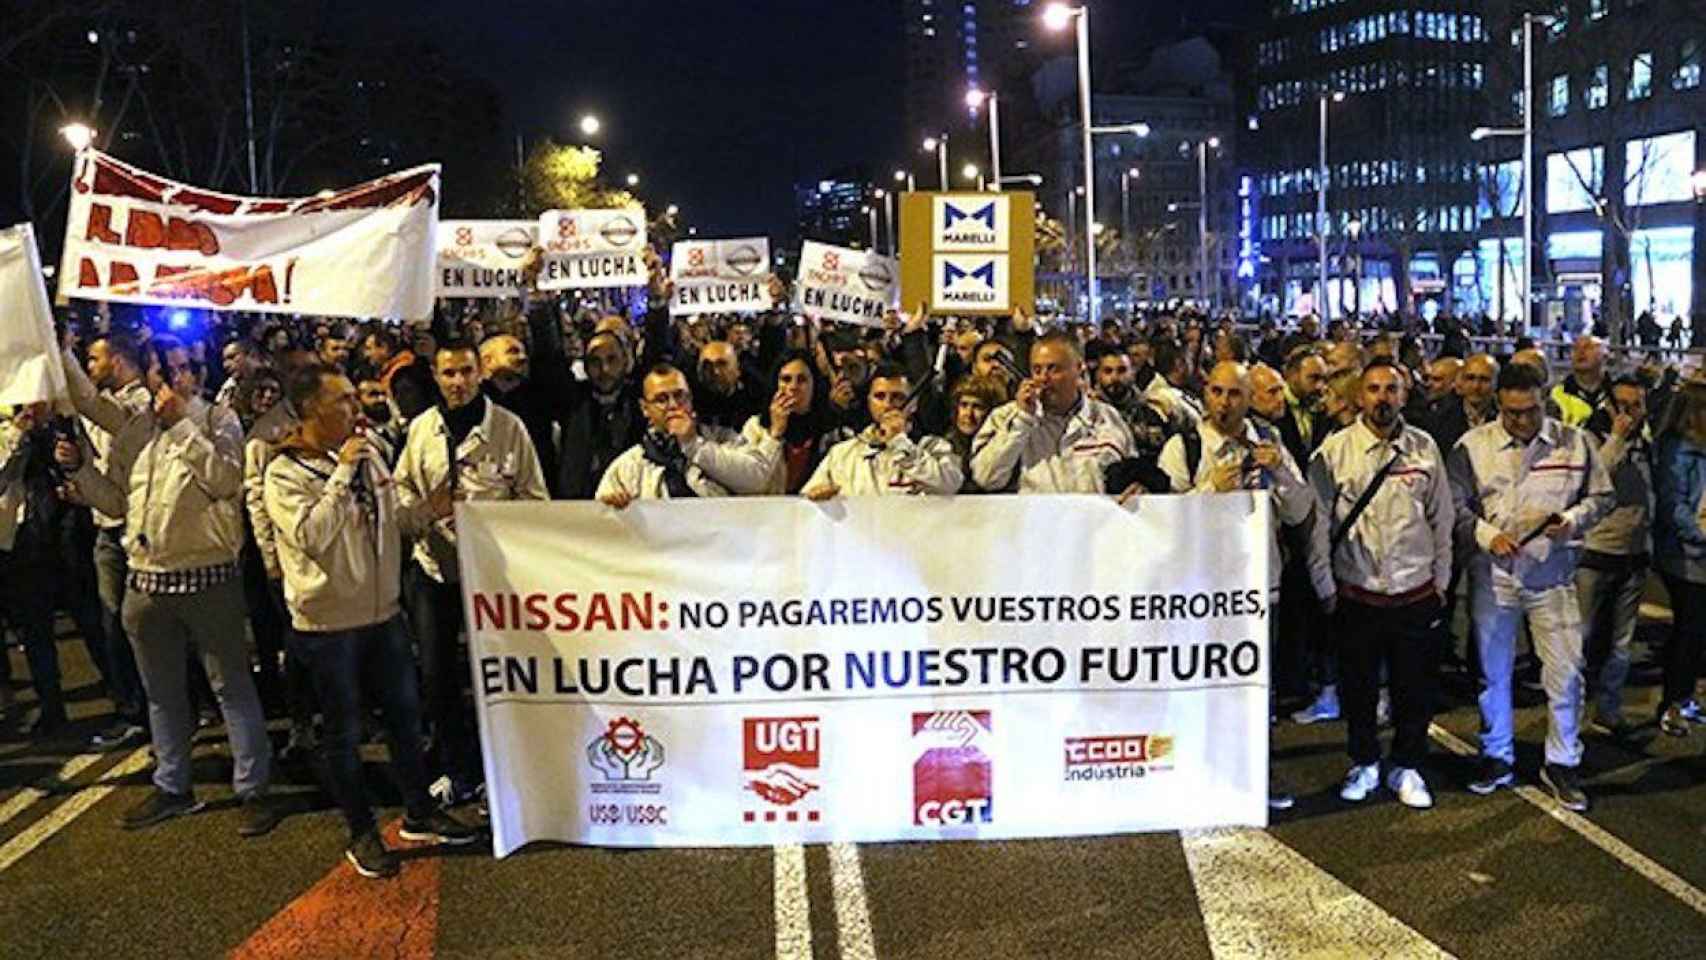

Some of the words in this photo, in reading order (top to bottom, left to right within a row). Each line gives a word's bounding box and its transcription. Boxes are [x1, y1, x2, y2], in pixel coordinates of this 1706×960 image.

[943, 233, 995, 243] MARELLI
[444, 268, 464, 287] EN
[548, 260, 570, 280] EN
[579, 256, 637, 277] LUCHA
[679, 286, 698, 305] EN
[707, 282, 762, 302] LUCHA
[804, 287, 823, 308] EN
[831, 294, 884, 318] LUCHA
[943, 291, 995, 302] MARELLI
[473, 592, 670, 632] NISSAN:
[680, 601, 729, 629] NO
[738, 597, 943, 626] PAGAREMOS
[950, 593, 1121, 623] VUESTROS
[1130, 590, 1267, 621] ERRORES,
[481, 656, 538, 697] EN
[554, 656, 718, 696] LUCHA
[732, 653, 831, 694] POR
[844, 648, 1066, 690] NUESTRO
[1080, 640, 1261, 683] FUTURO
[755, 720, 820, 752] UGT
[918, 800, 988, 825] CGT
